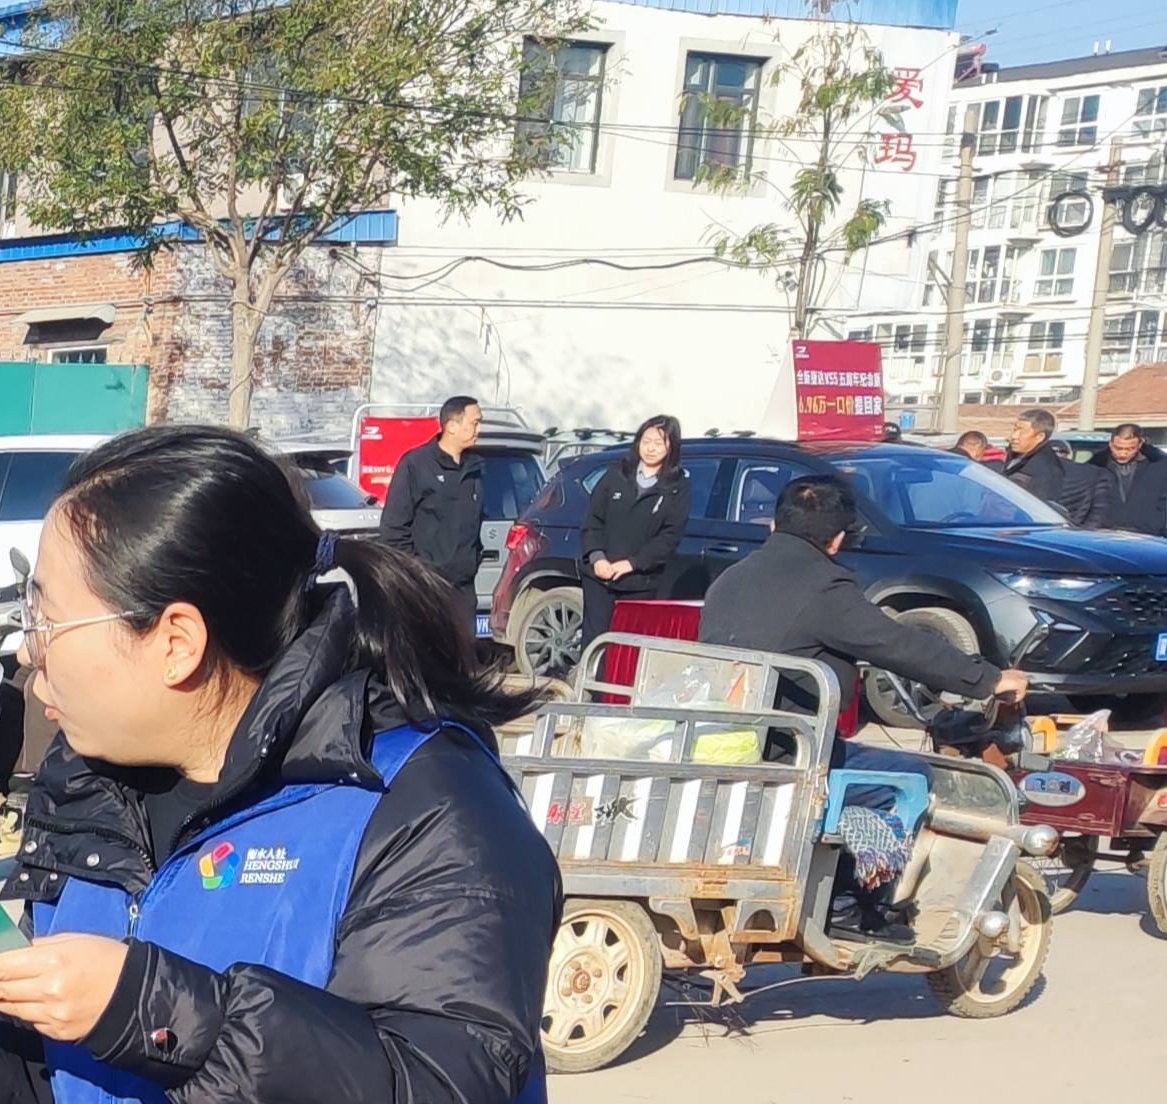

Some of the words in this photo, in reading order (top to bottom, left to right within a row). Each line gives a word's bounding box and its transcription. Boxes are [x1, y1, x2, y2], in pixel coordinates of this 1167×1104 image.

[875, 66, 924, 172] 爱玛
[242, 858, 301, 872] HENGSHUI
[239, 872, 286, 884] RENSHE
